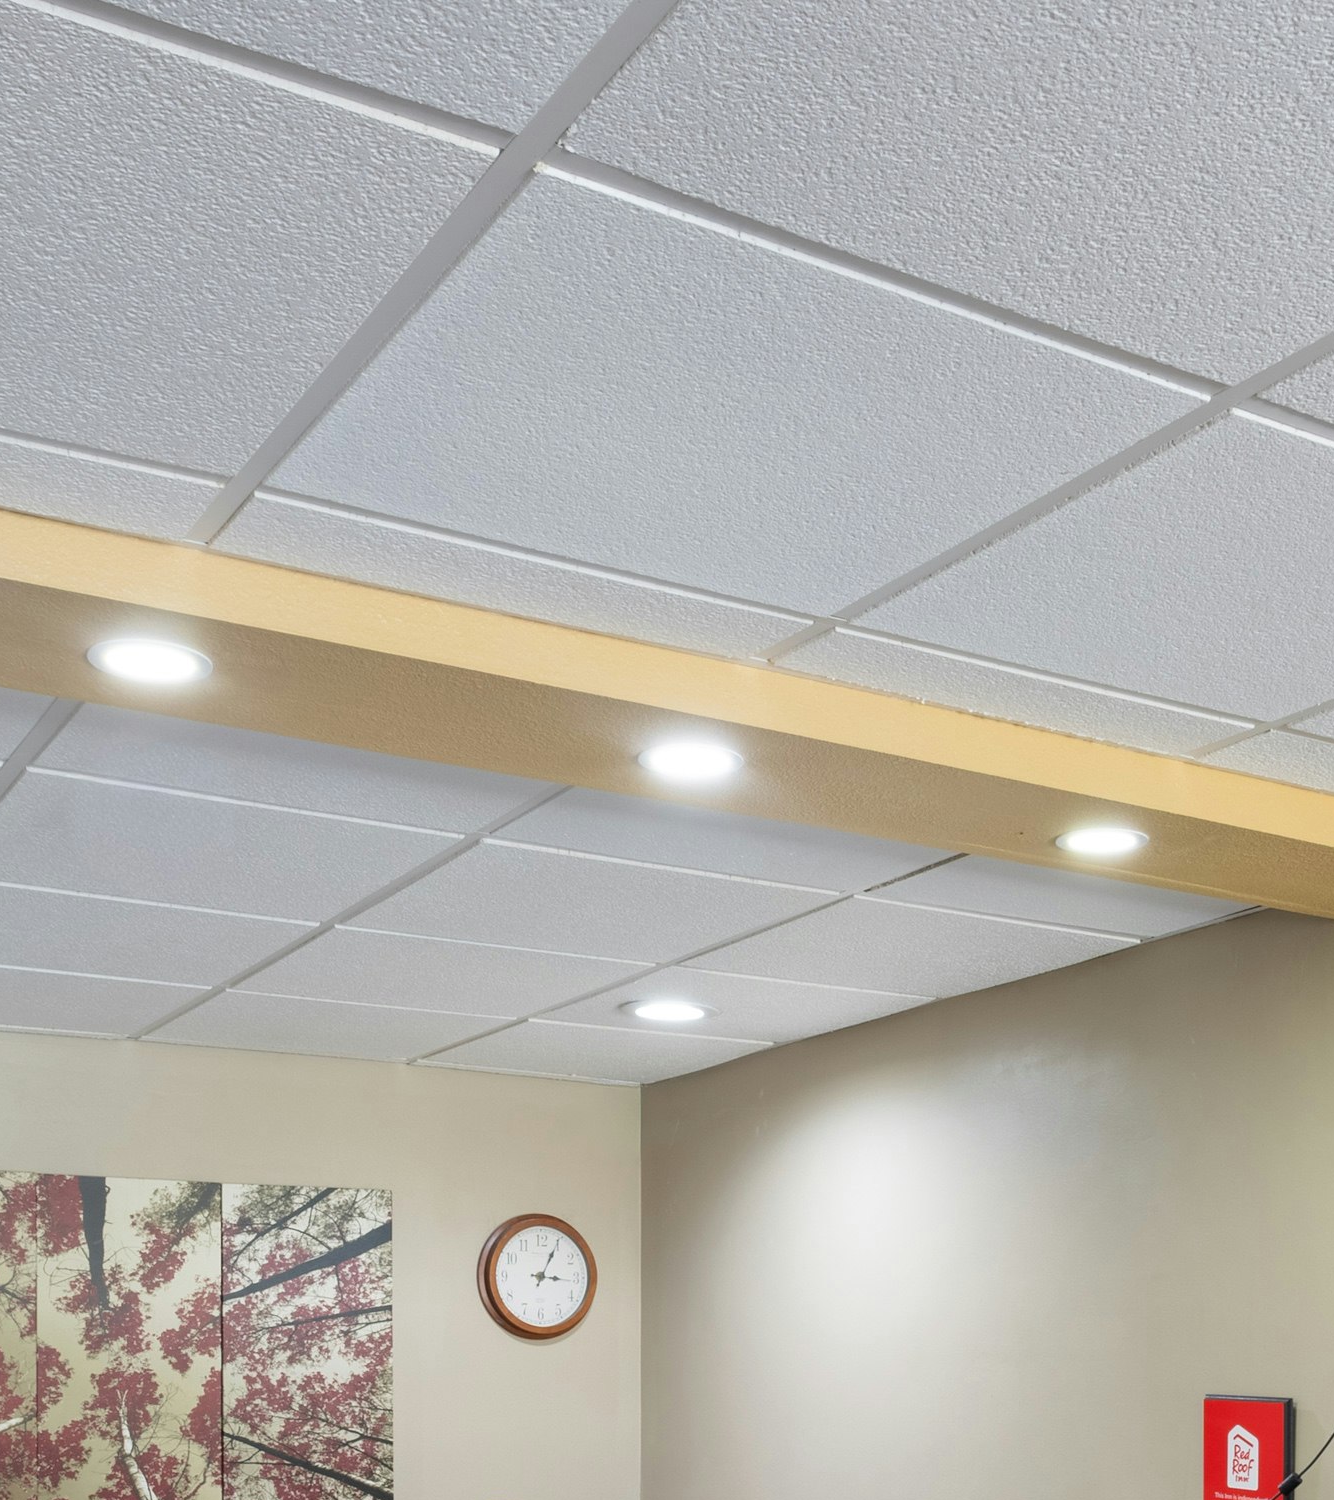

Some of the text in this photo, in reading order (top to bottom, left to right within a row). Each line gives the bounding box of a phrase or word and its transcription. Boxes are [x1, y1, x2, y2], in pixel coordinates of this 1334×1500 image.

[520, 1240, 528, 1252] 11
[536, 1234, 547, 1247] 12
[507, 1252, 518, 1265] 10
[567, 1253, 574, 1265] 2
[573, 1272, 580, 1284] 3
[522, 1303, 528, 1315] 7
[538, 1307, 544, 1320] 6
[555, 1303, 562, 1317] 5
[1234, 1444, 1251, 1460] Red
[1232, 1459, 1254, 1476] Roof
